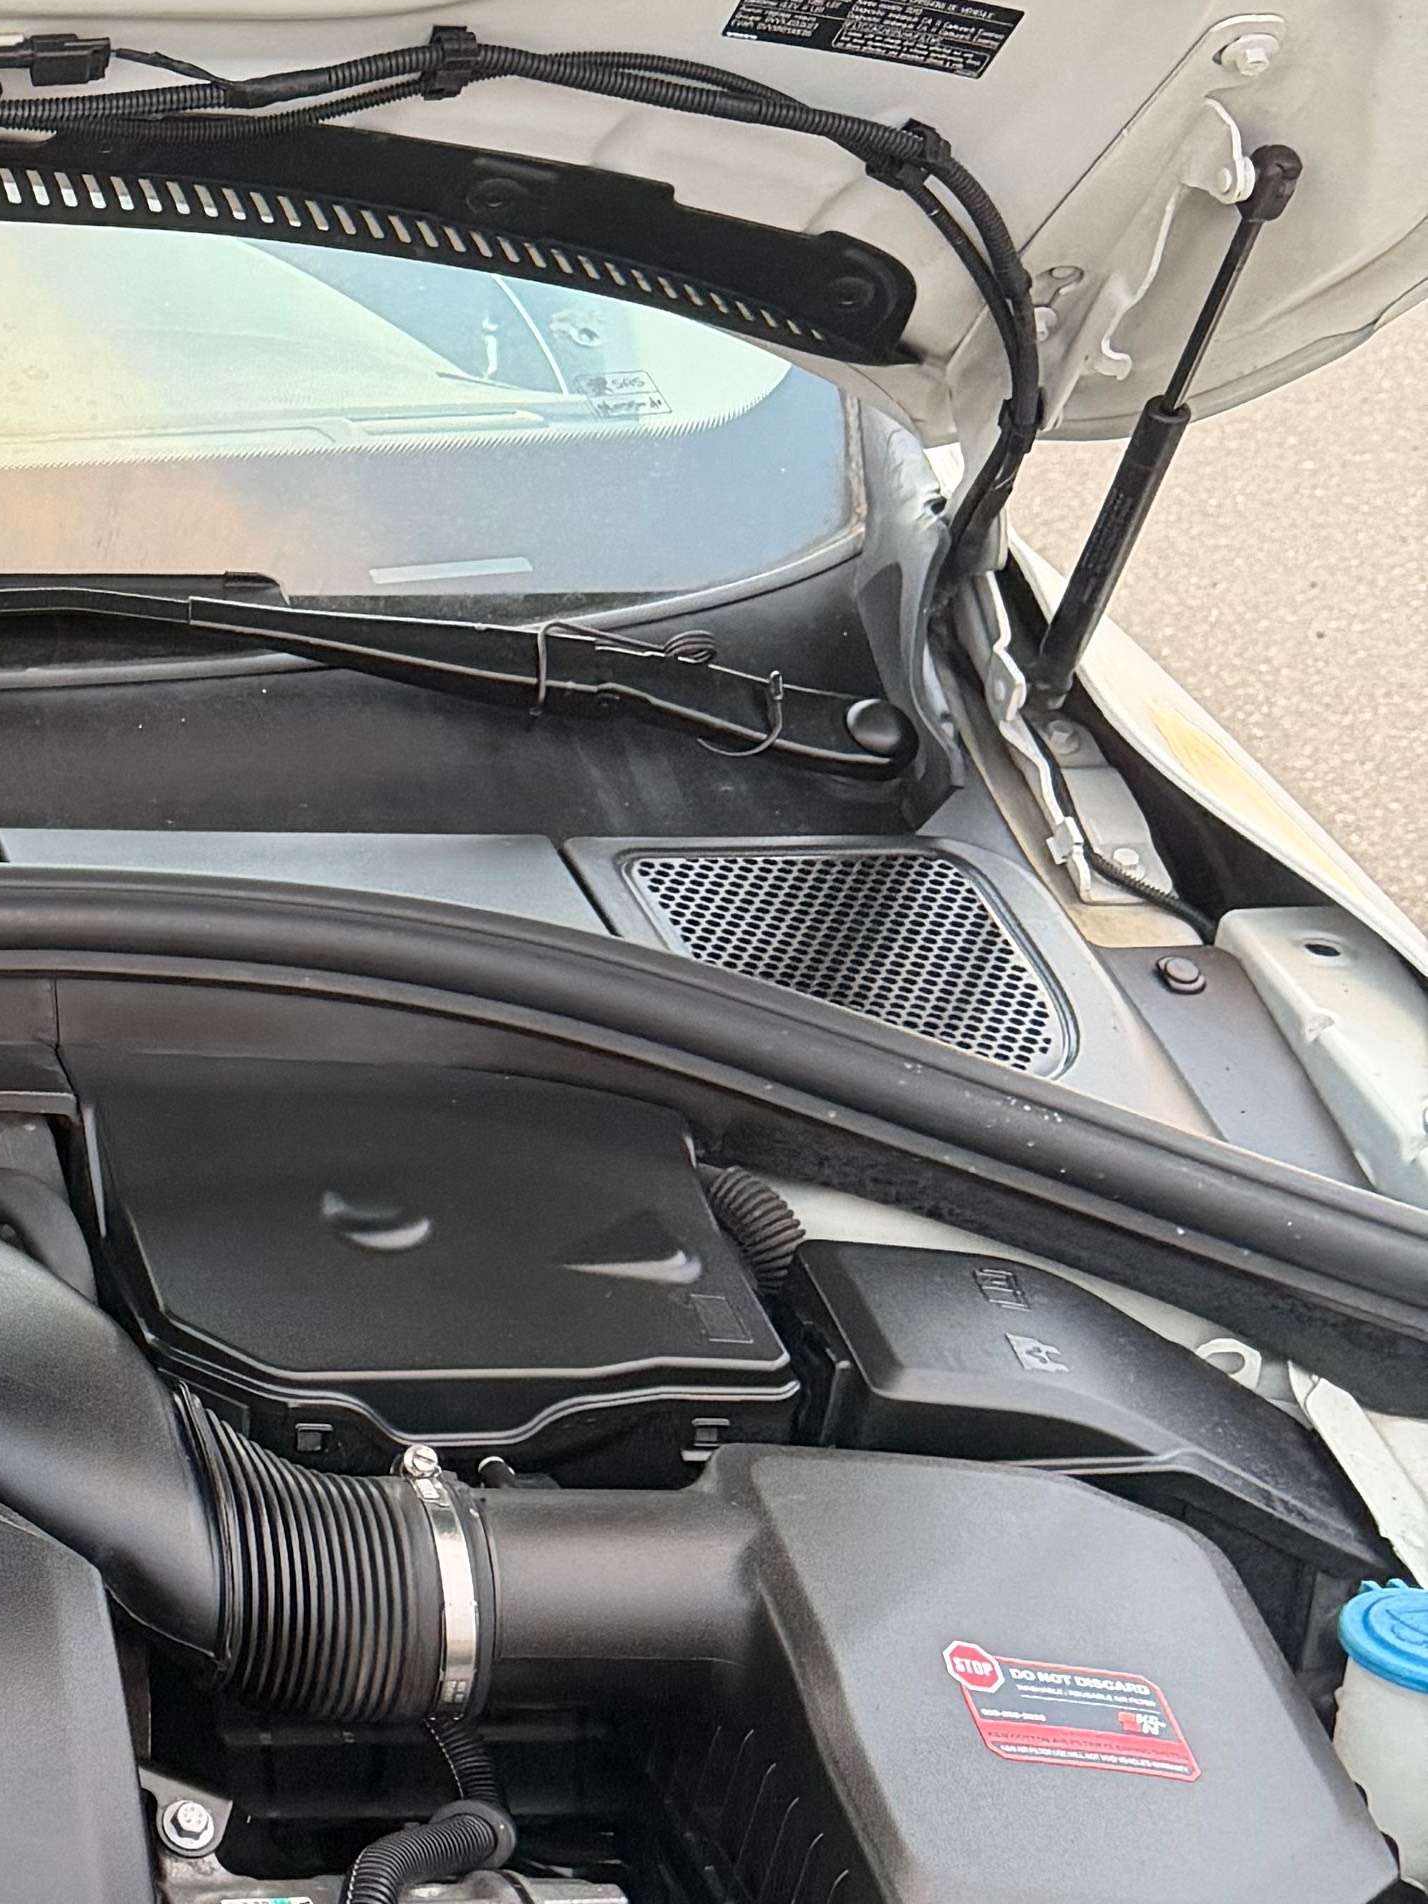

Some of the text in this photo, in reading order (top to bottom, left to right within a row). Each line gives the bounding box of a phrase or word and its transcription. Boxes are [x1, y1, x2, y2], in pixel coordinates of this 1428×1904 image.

[952, 1657, 993, 1676] STOP
[1009, 1668, 1151, 1696] DO NOT DISCARD
